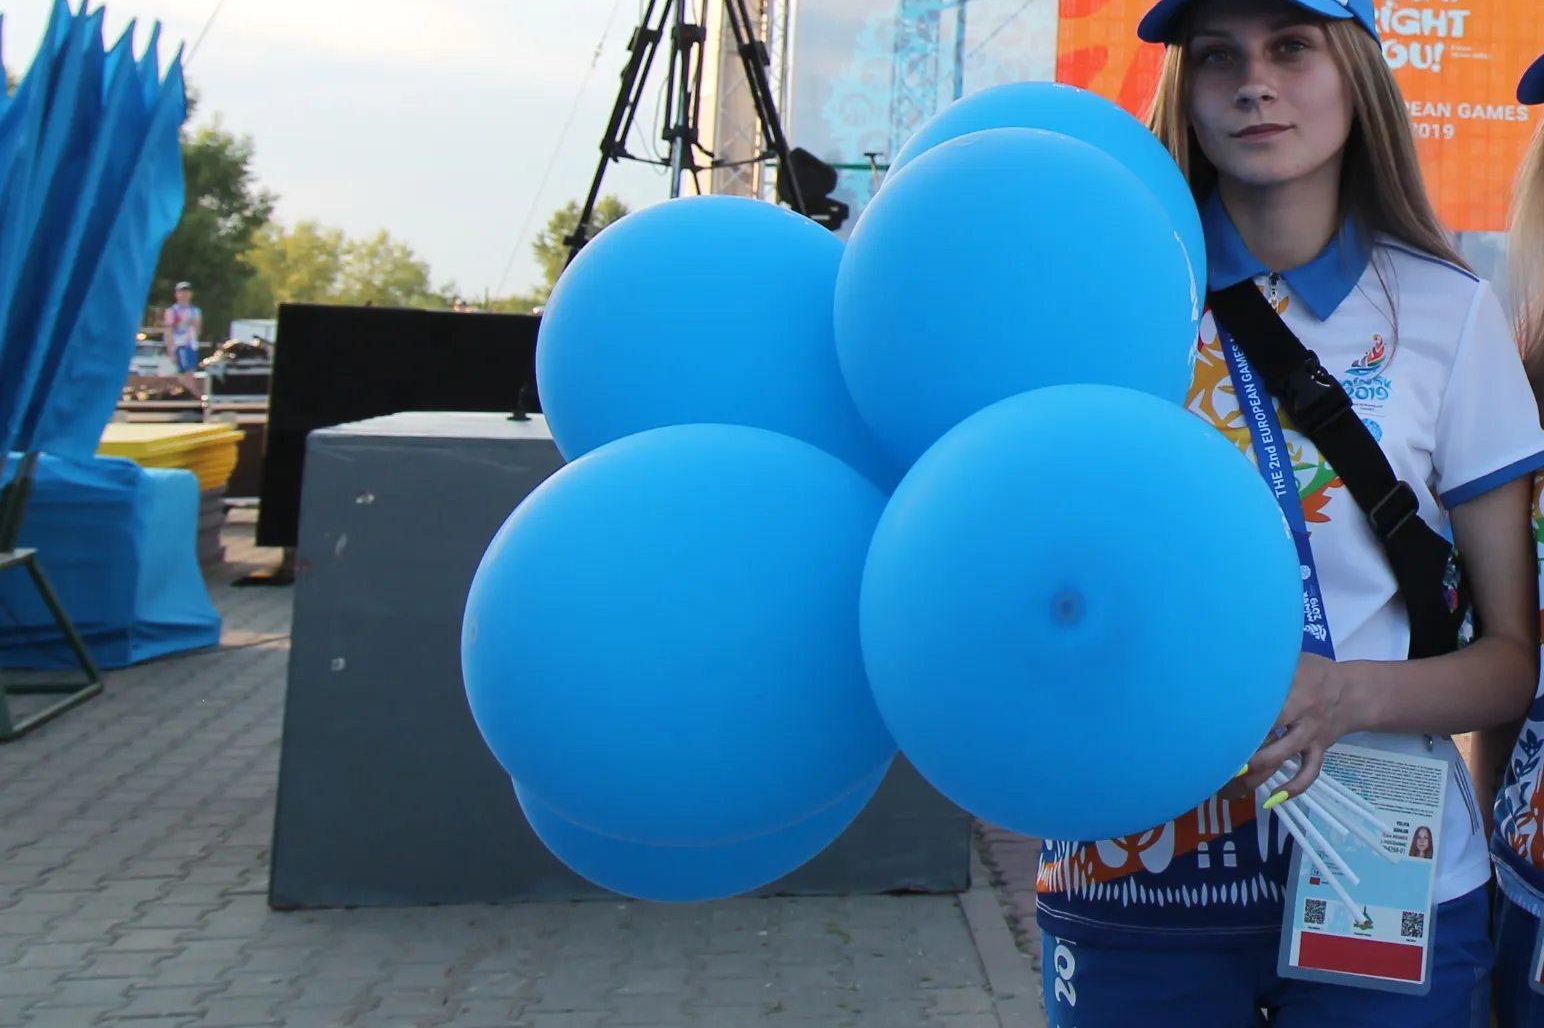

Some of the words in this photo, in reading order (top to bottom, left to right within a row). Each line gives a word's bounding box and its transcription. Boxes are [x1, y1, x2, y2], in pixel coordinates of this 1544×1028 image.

[1375, 0, 1471, 38] IGHT
[1381, 39, 1445, 72] OU!
[1457, 102, 1529, 122] GAMES
[1244, 383, 1274, 444] EUROPEAN
[1264, 446, 1281, 470] 2nd
[1271, 470, 1287, 499] THE
